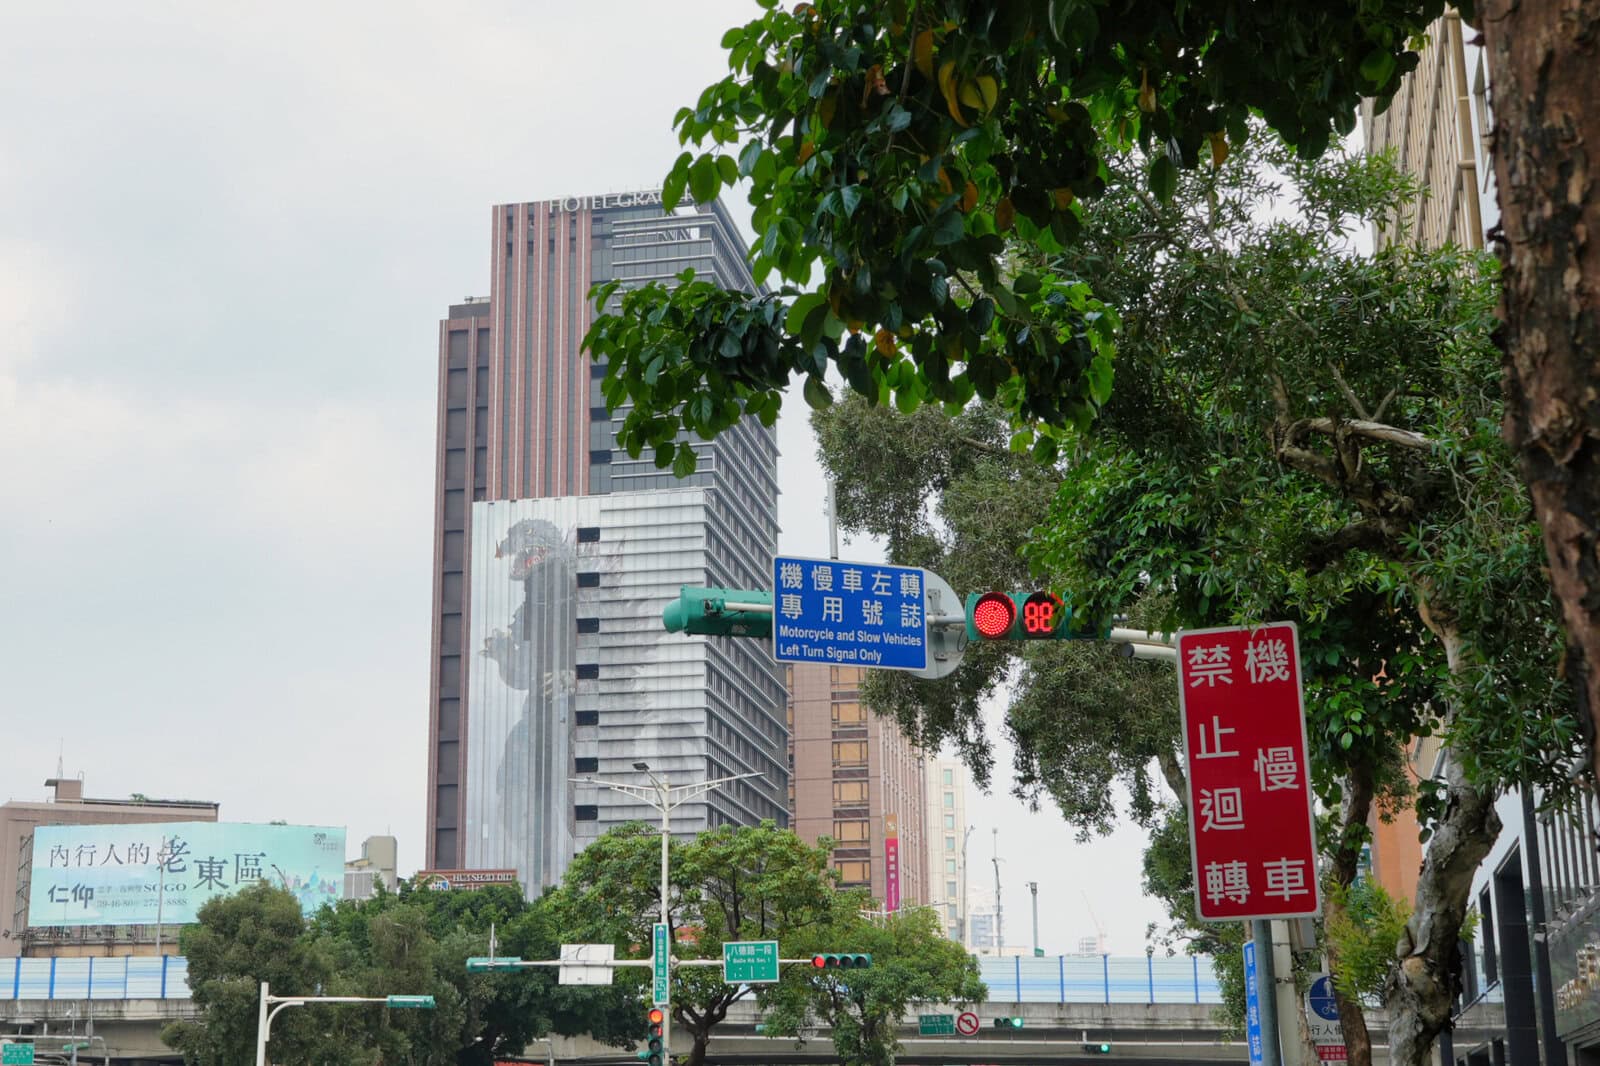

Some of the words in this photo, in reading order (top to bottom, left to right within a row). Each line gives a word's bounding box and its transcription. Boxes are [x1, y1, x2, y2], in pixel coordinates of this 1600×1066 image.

[549, 197, 613, 213] HOTEL
[779, 562, 921, 599] 機慢車左轉
[780, 593, 921, 629] 專用號誌
[780, 625, 834, 641] Motorcycle
[837, 630, 855, 641] and
[857, 630, 881, 643] Slow
[883, 632, 922, 647] Vehicles
[780, 644, 799, 656] Left
[802, 645, 824, 657] Turn
[827, 647, 857, 662] Signal
[859, 649, 882, 664] Only
[1187, 644, 1251, 905] 禁止迴轉
[1244, 639, 1309, 902] 機慢車
[48, 883, 94, 908] 仁仰
